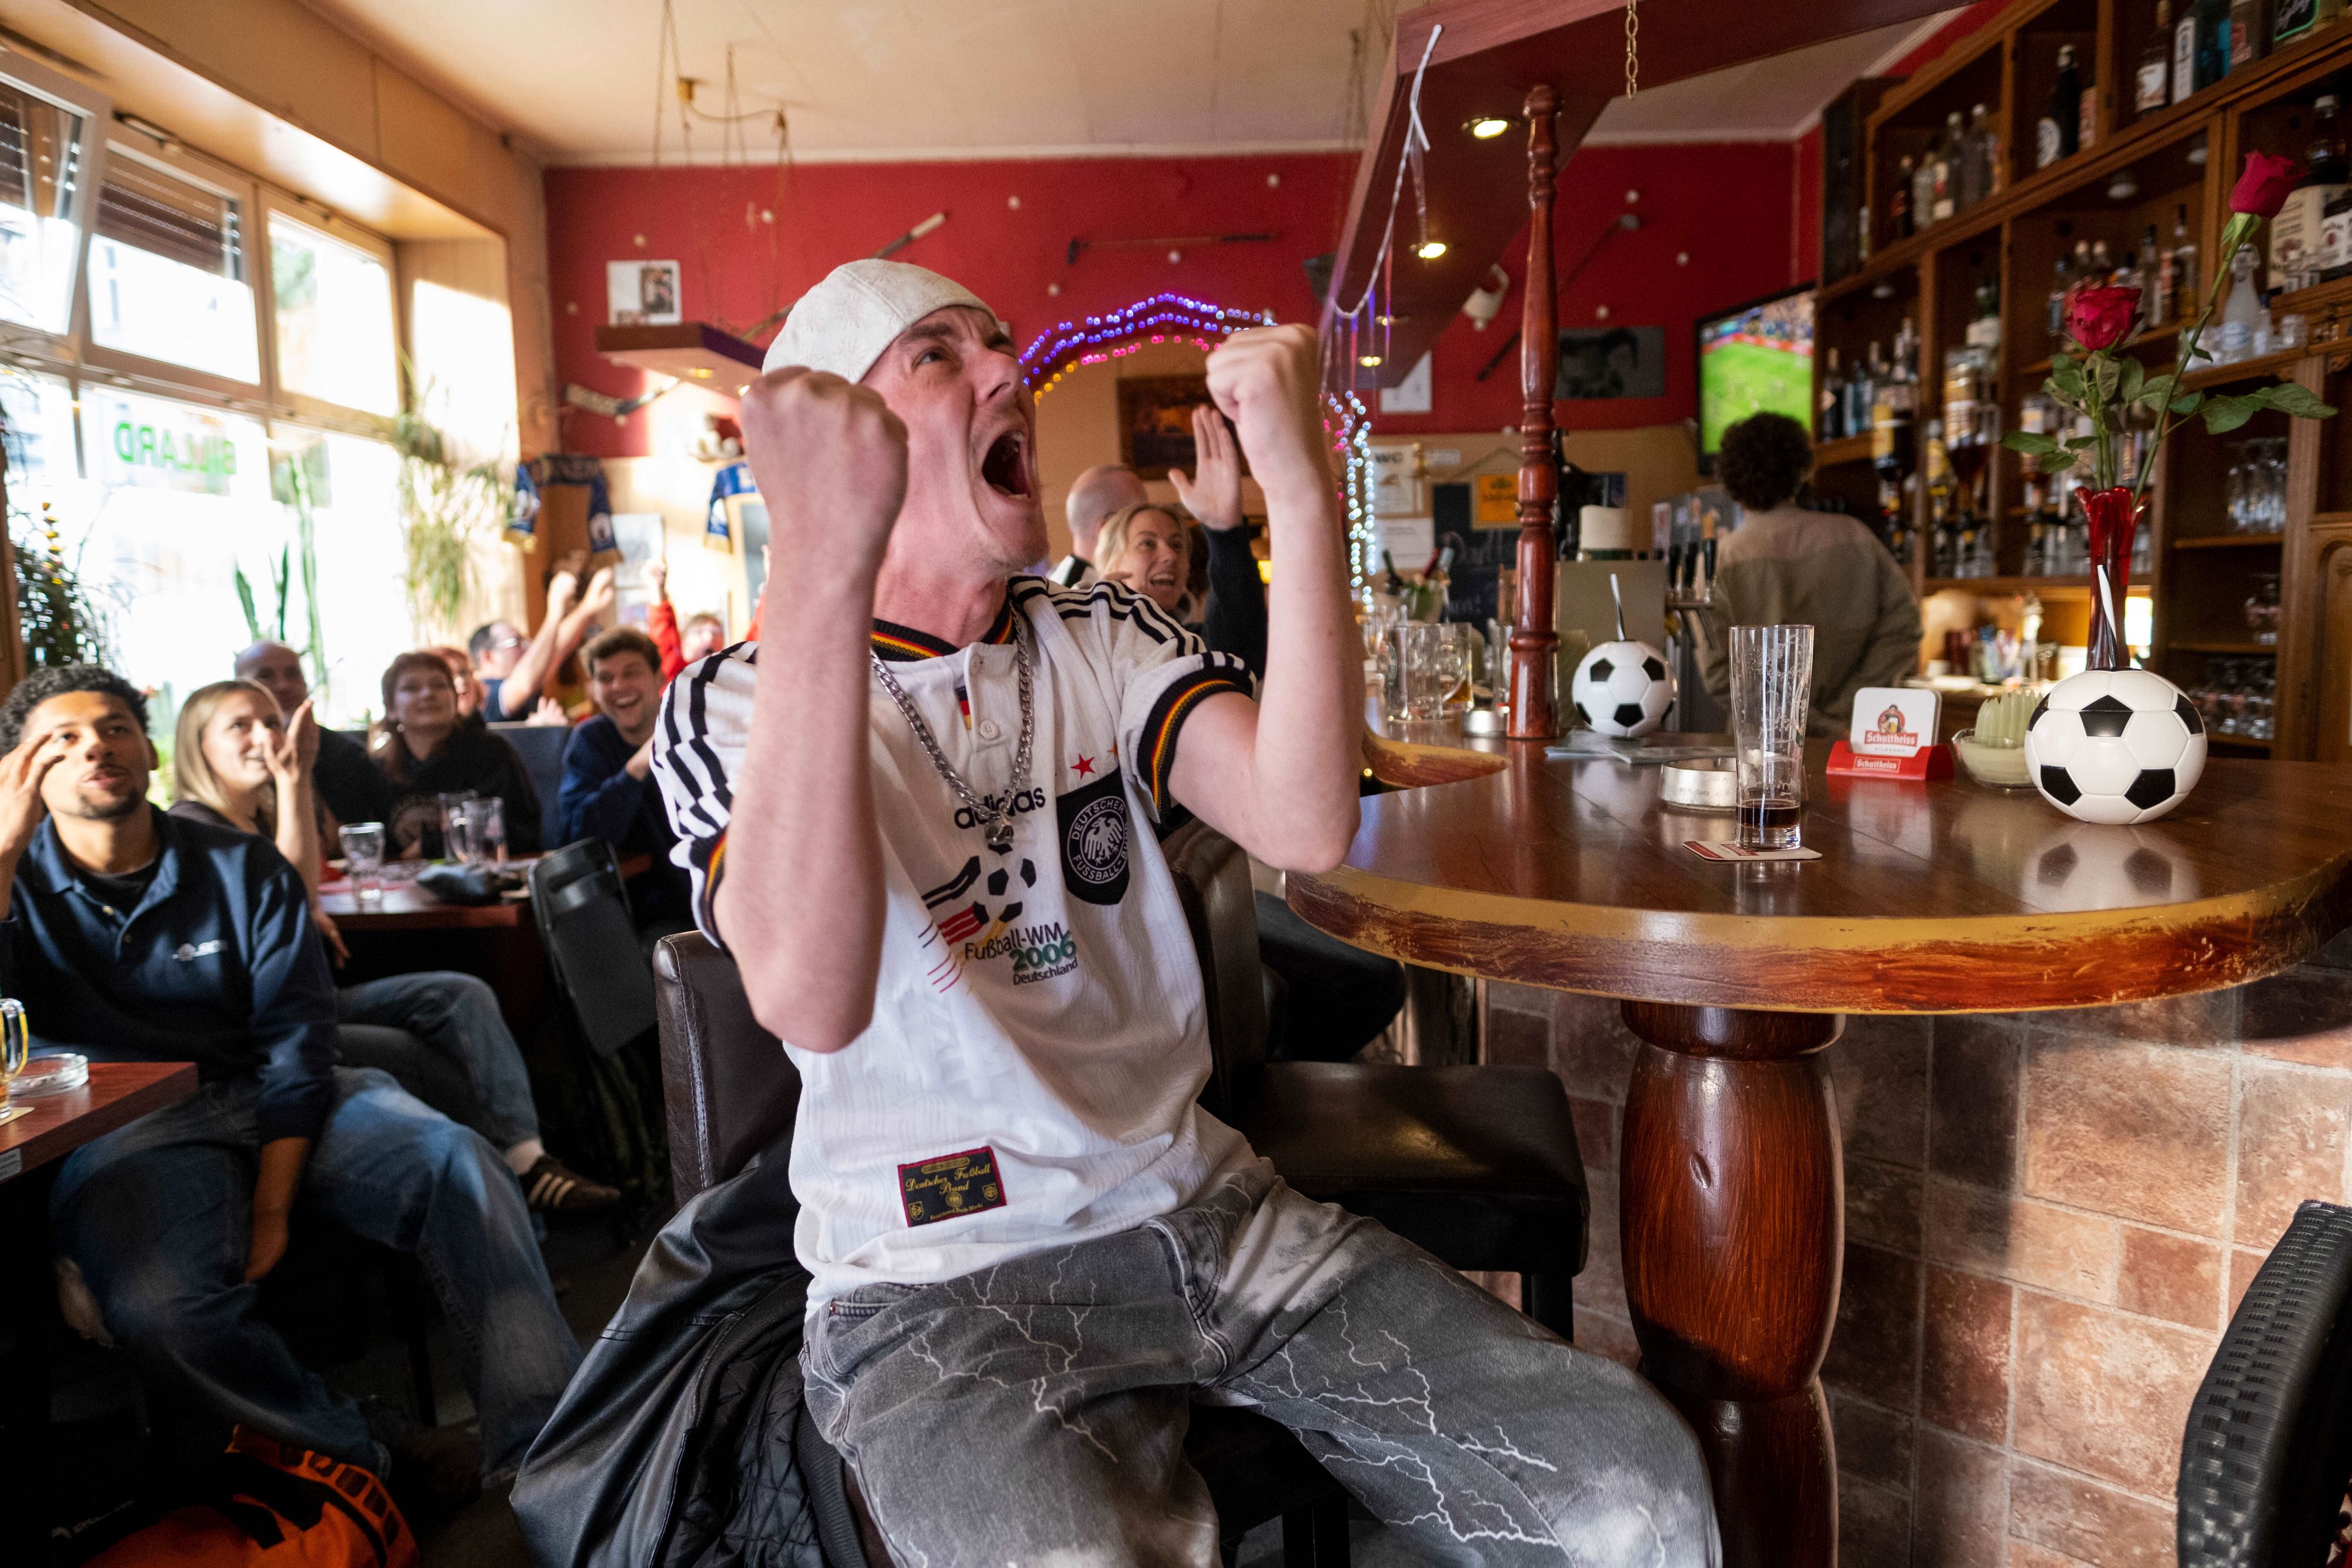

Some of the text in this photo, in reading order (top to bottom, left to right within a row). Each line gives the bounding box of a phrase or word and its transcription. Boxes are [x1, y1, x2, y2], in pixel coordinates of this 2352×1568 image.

[1375, 452, 1403, 463] WC
[1867, 733, 1915, 744] Schultheiss
[1857, 758, 1897, 770] Schultheiss
[1071, 800, 1125, 840] DEUTSCHER
[1073, 823, 1128, 881] FUSSBALL-BU
[964, 922, 1064, 960] Fußball-WM
[1009, 930, 1077, 972] 2006
[1013, 957, 1078, 985] Deutschland
[906, 1175, 948, 1191] Deutscher
[955, 1164, 990, 1180] Fußball
[939, 1180, 969, 1195] Bund
